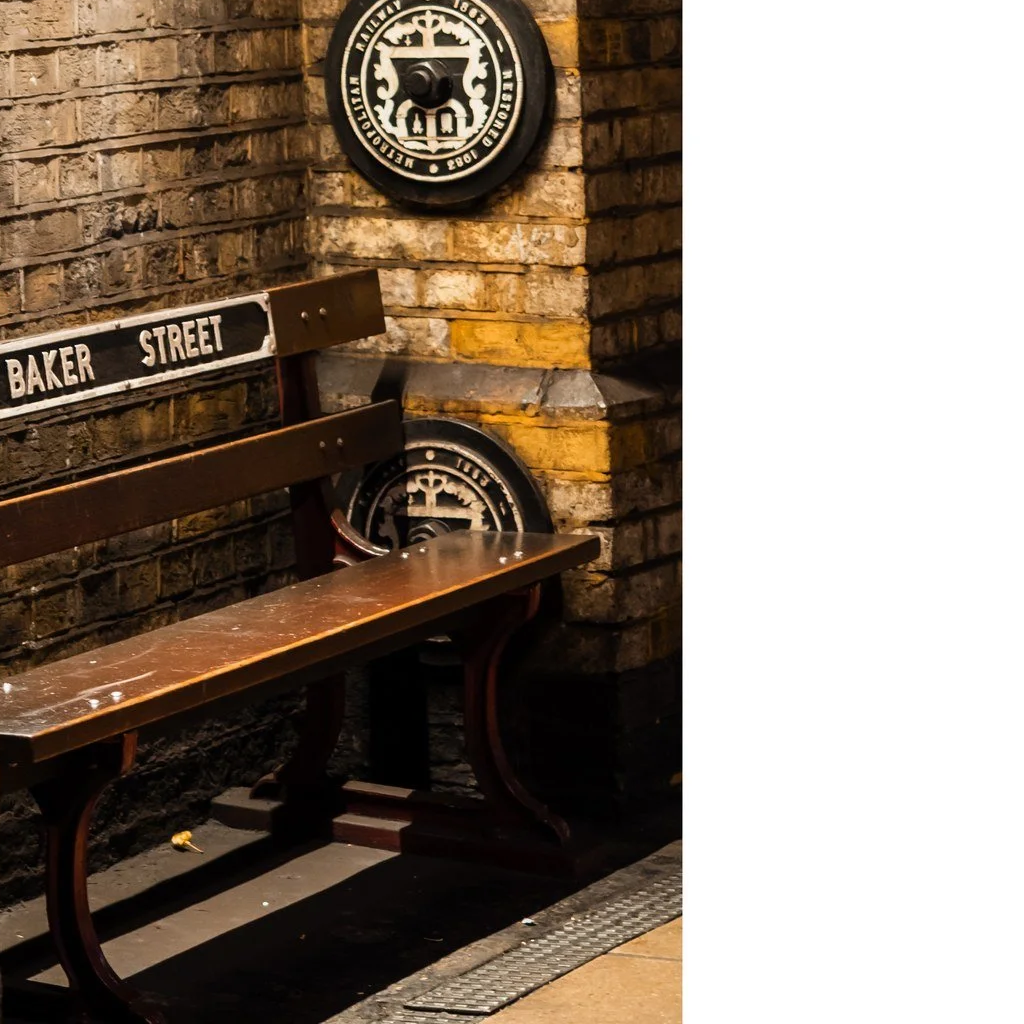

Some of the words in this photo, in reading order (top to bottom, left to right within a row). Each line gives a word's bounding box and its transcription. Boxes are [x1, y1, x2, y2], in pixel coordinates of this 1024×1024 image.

[355, 0, 402, 53] RAILWAY
[349, 76, 415, 169] METROPOLITAN
[482, 69, 513, 148] RESTORED
[446, 149, 479, 170] 1983
[5, 343, 95, 399] BAKER
[139, 314, 223, 368] STREET
